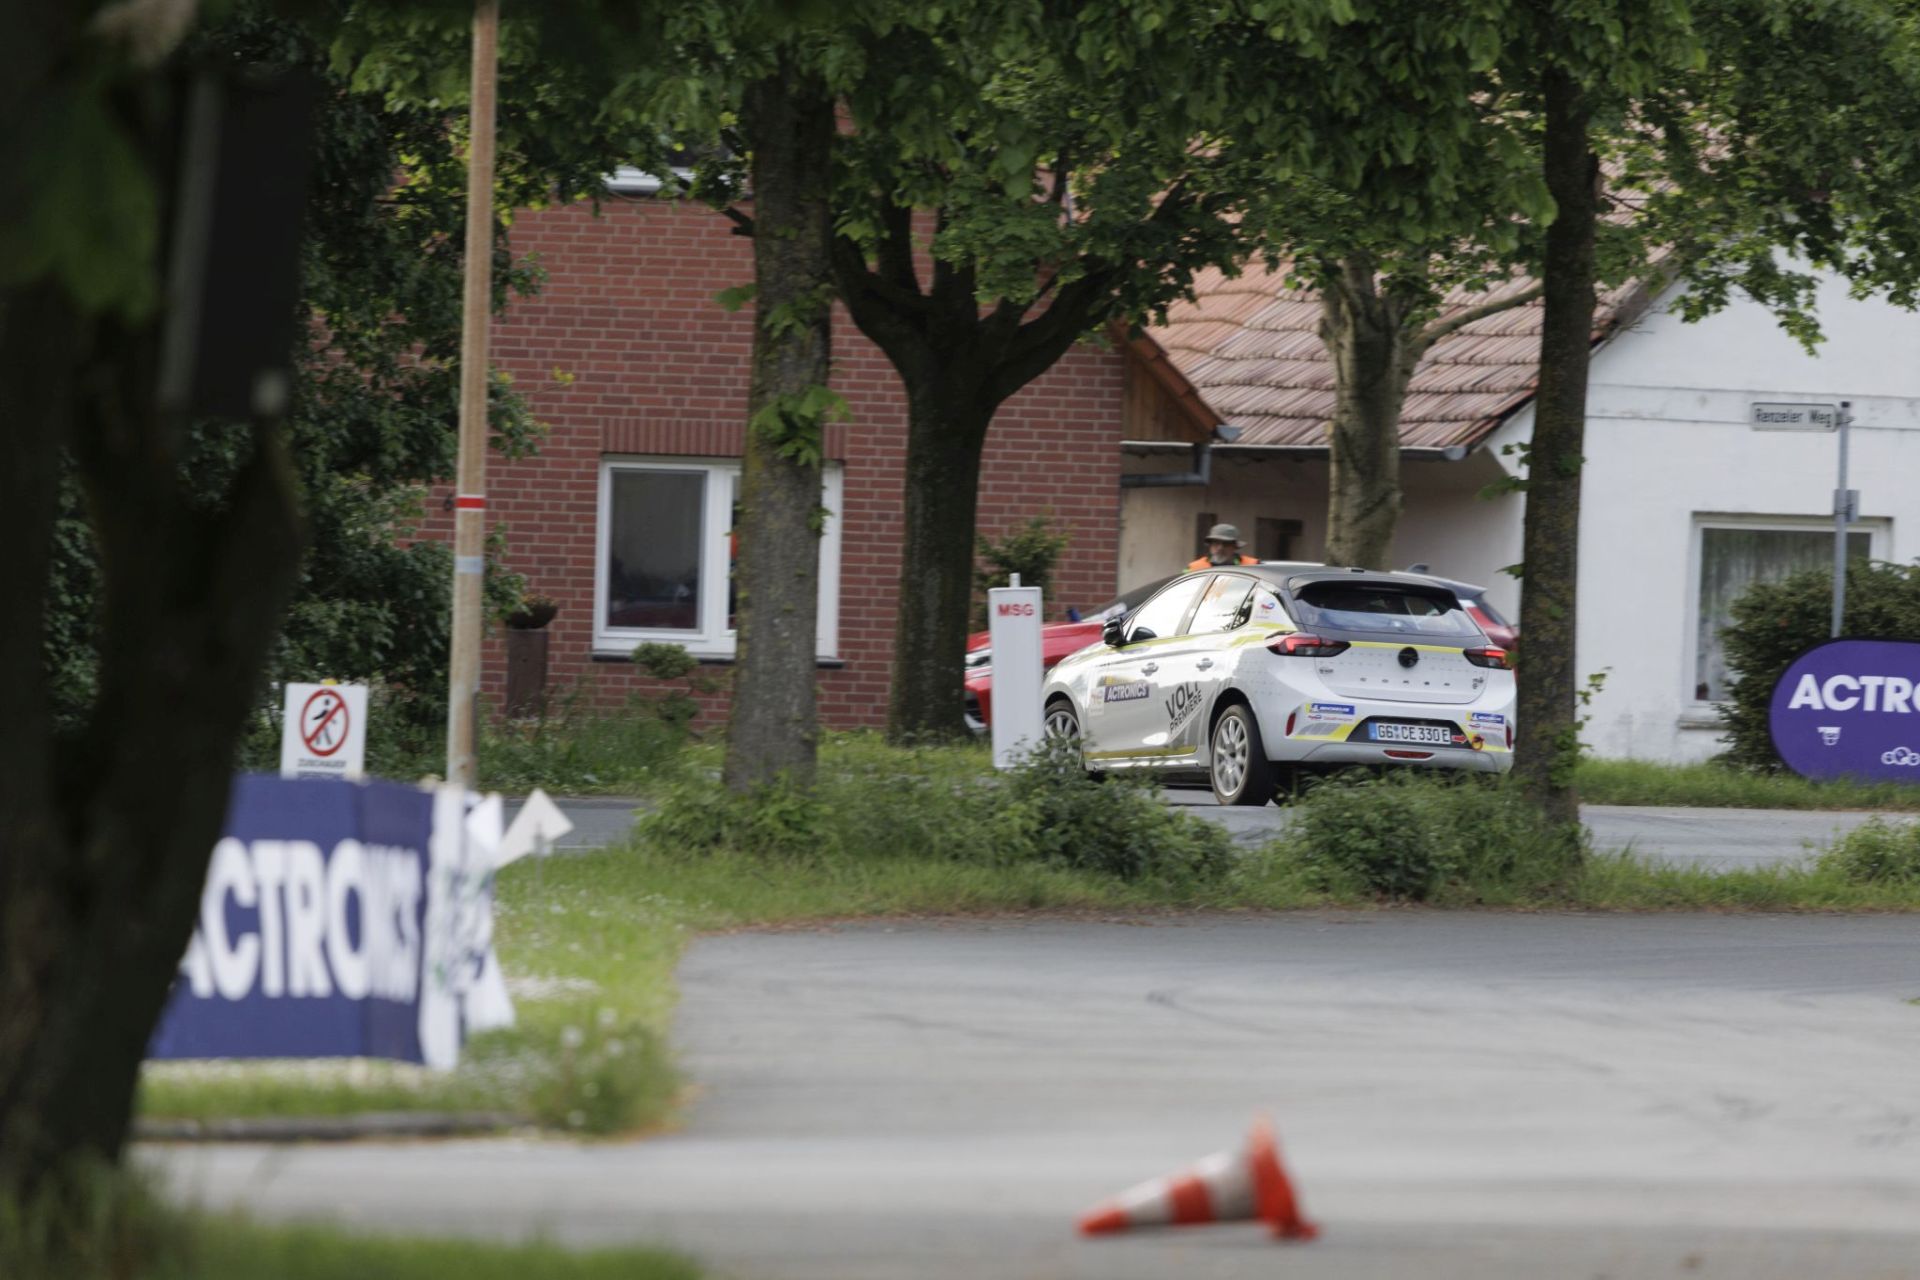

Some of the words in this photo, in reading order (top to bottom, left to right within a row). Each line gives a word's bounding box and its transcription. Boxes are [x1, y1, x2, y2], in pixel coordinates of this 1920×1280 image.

[1808, 409, 1832, 428] Weg
[997, 603, 1034, 616] MSG
[1107, 683, 1147, 701] ACTRONICS
[1788, 673, 1920, 713] ACTR
[1170, 689, 1202, 734] PREMIERE
